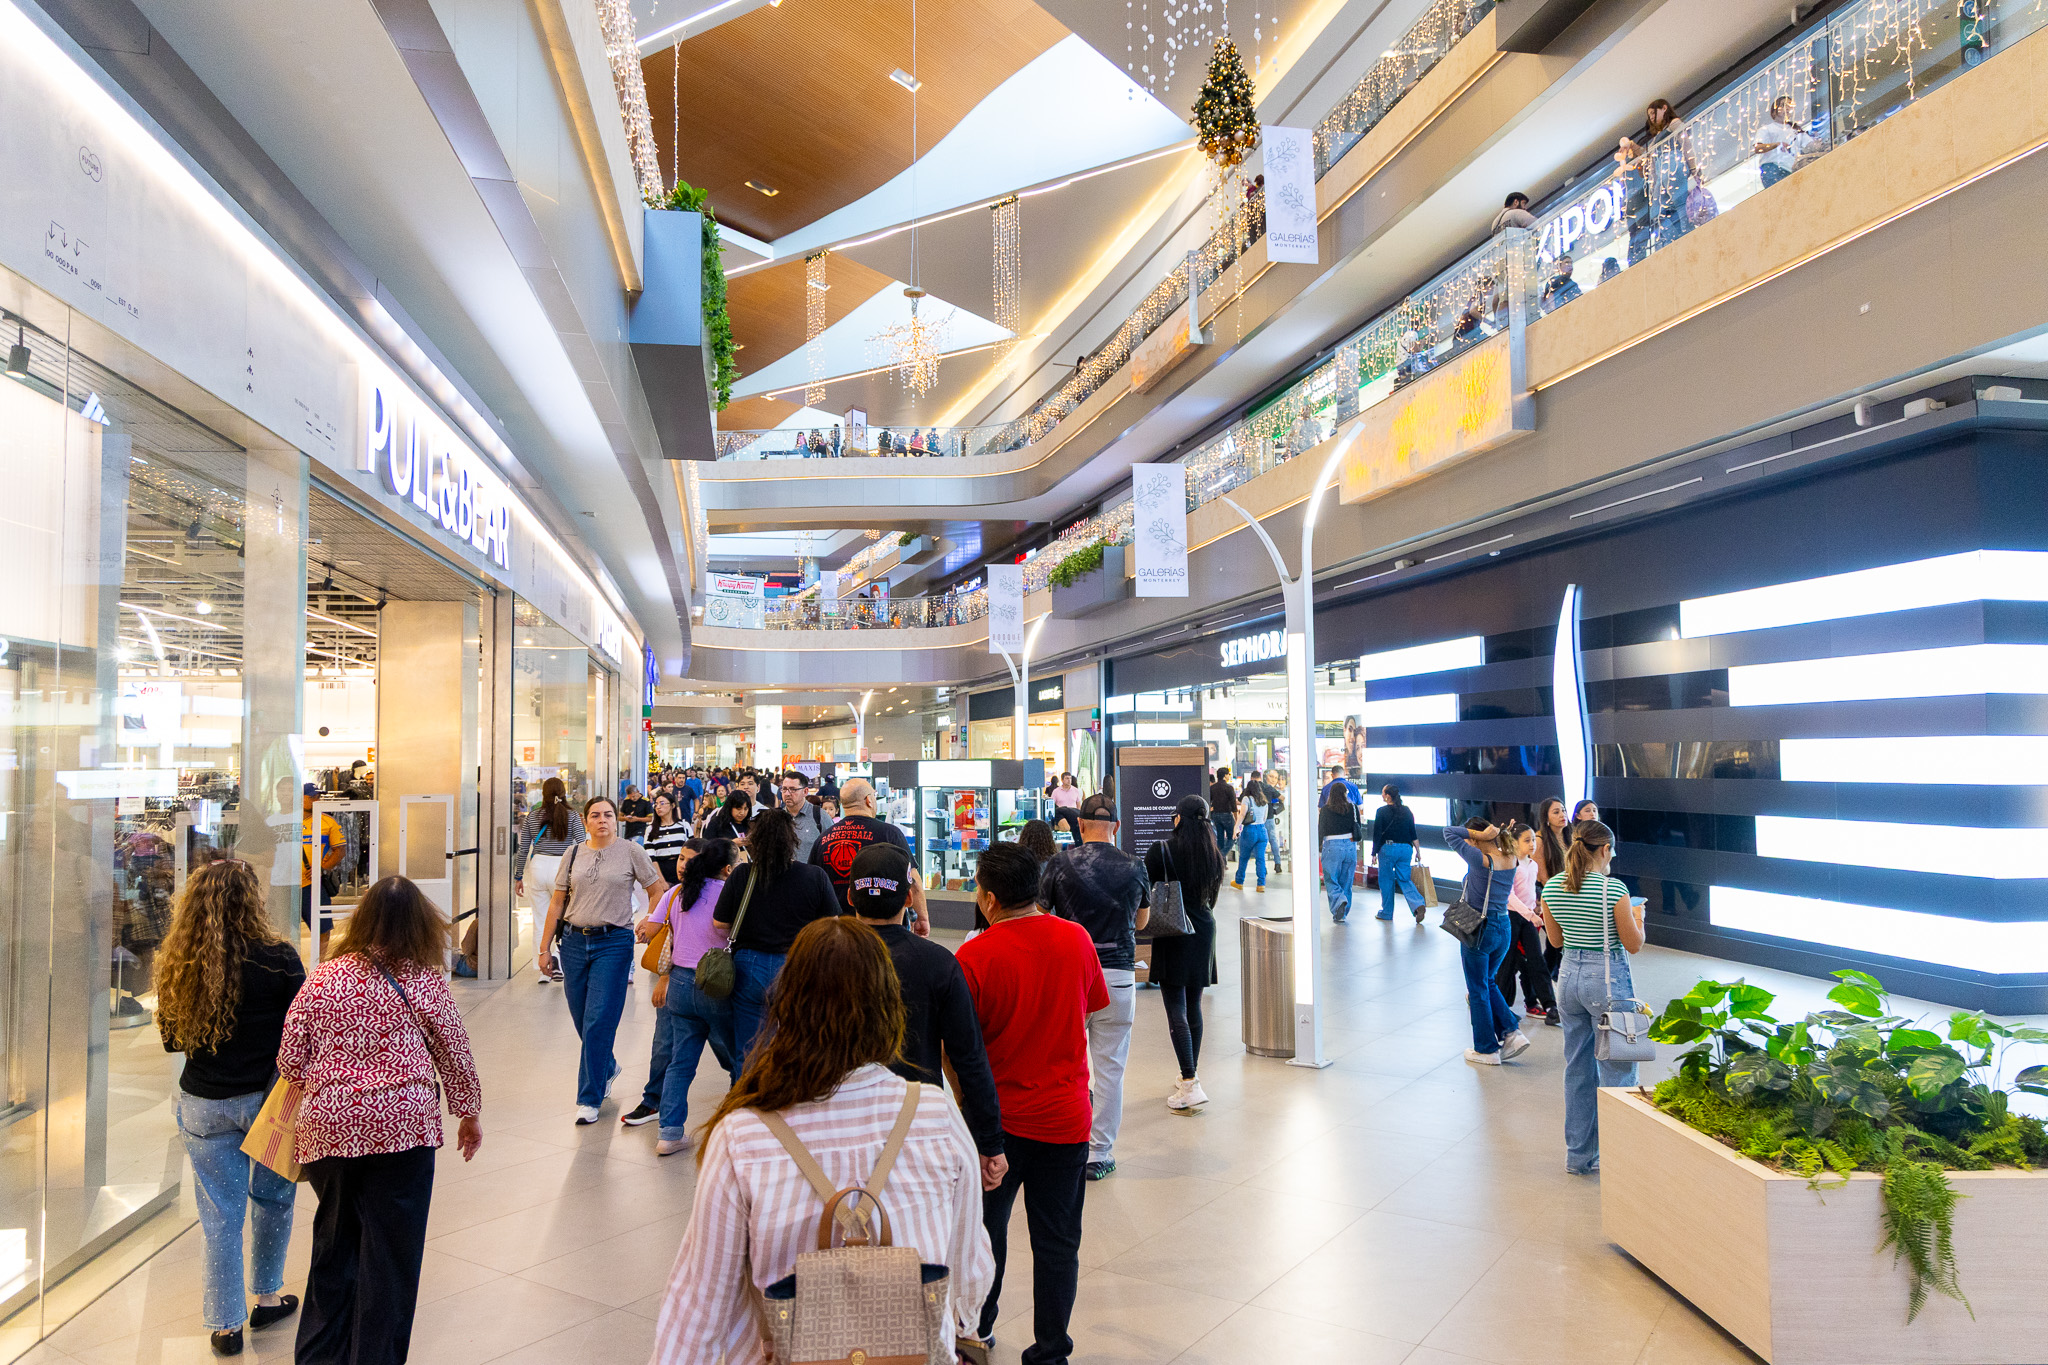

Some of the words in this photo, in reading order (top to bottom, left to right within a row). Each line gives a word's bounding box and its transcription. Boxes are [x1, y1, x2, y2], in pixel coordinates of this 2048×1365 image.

[362, 374, 511, 571] PULL&BEAR
[832, 824, 866, 832] NATIONAL
[820, 830, 874, 846] BASKETBALL
[854, 877, 873, 891] NEW
[873, 877, 899, 892] YORK
